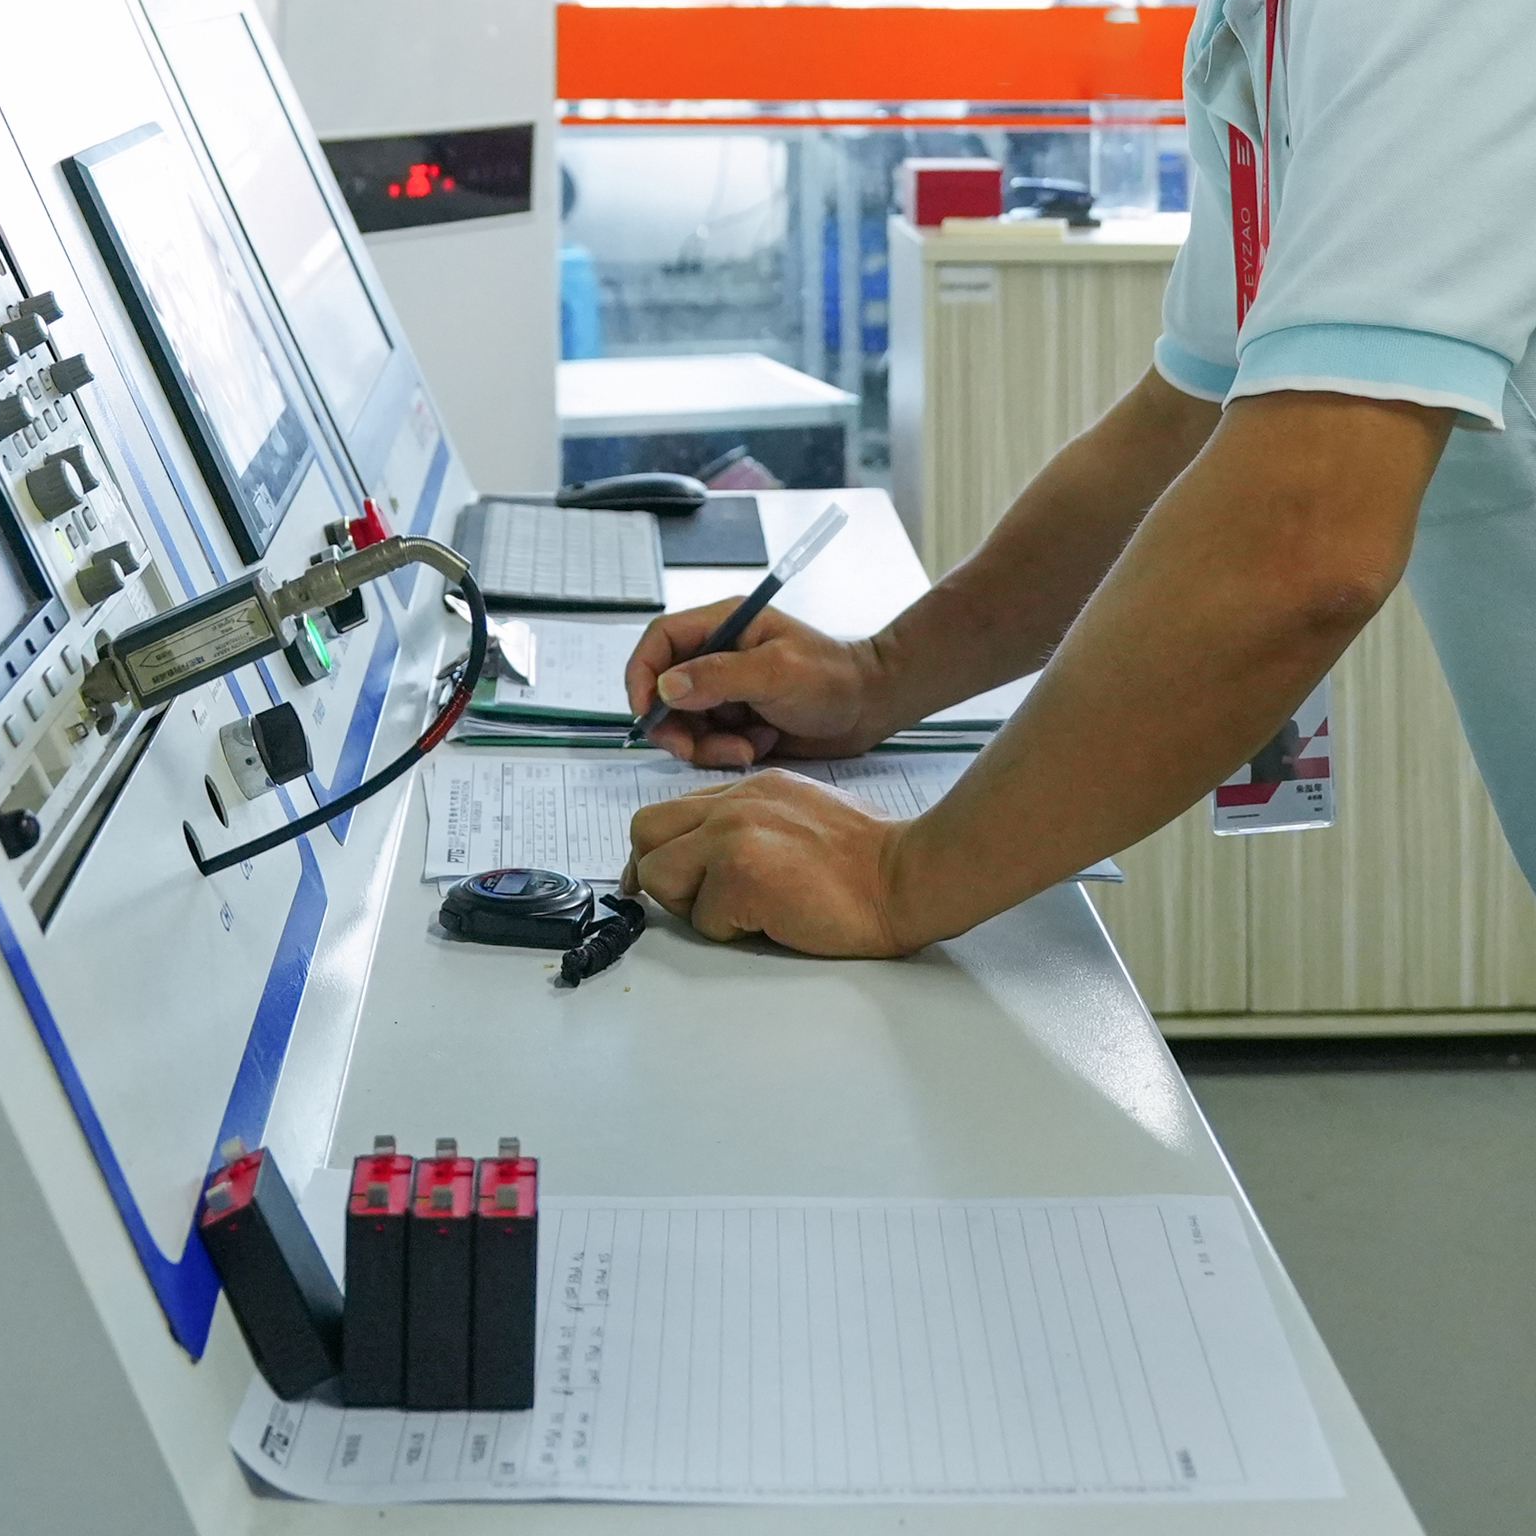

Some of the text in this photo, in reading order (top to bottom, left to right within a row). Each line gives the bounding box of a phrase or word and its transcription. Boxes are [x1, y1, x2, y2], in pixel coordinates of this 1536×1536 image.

[1244, 206, 1256, 287] EYZAO
[447, 848, 465, 864] PTG
[220, 900, 234, 932] CH1
